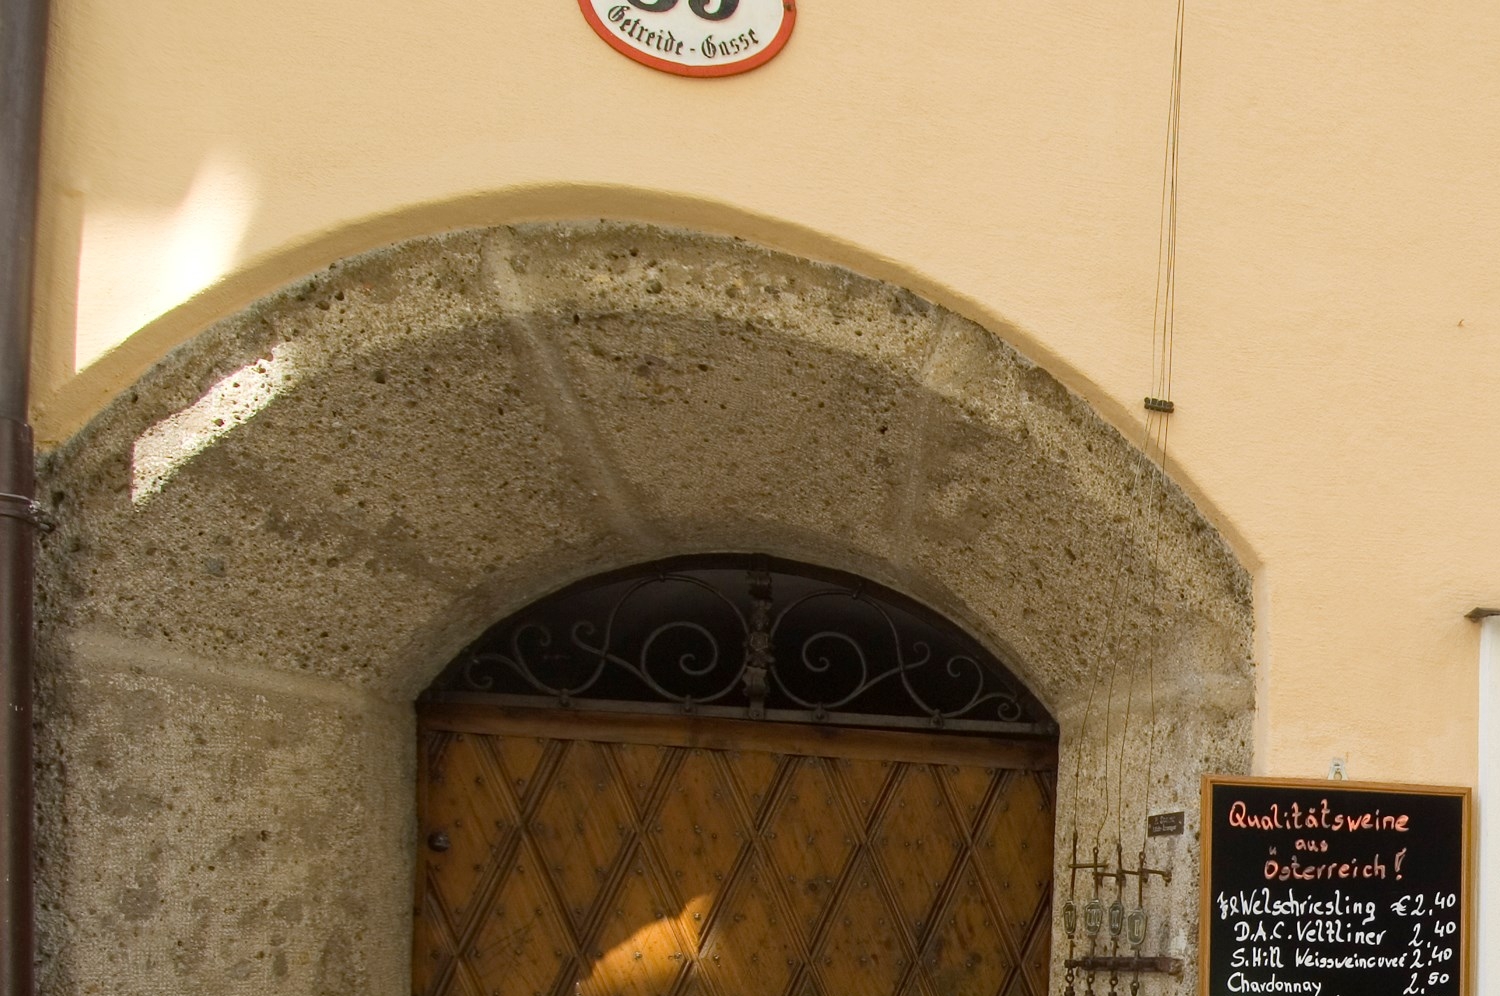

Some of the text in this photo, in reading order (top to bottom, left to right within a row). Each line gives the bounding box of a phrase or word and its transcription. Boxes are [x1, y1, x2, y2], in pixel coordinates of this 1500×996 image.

[1229, 799, 1409, 832] Qualitätsweine
[1295, 839, 1328, 853] aus
[1240, 887, 1376, 925] Welschriesling
[1297, 921, 1386, 946] Veltliner
